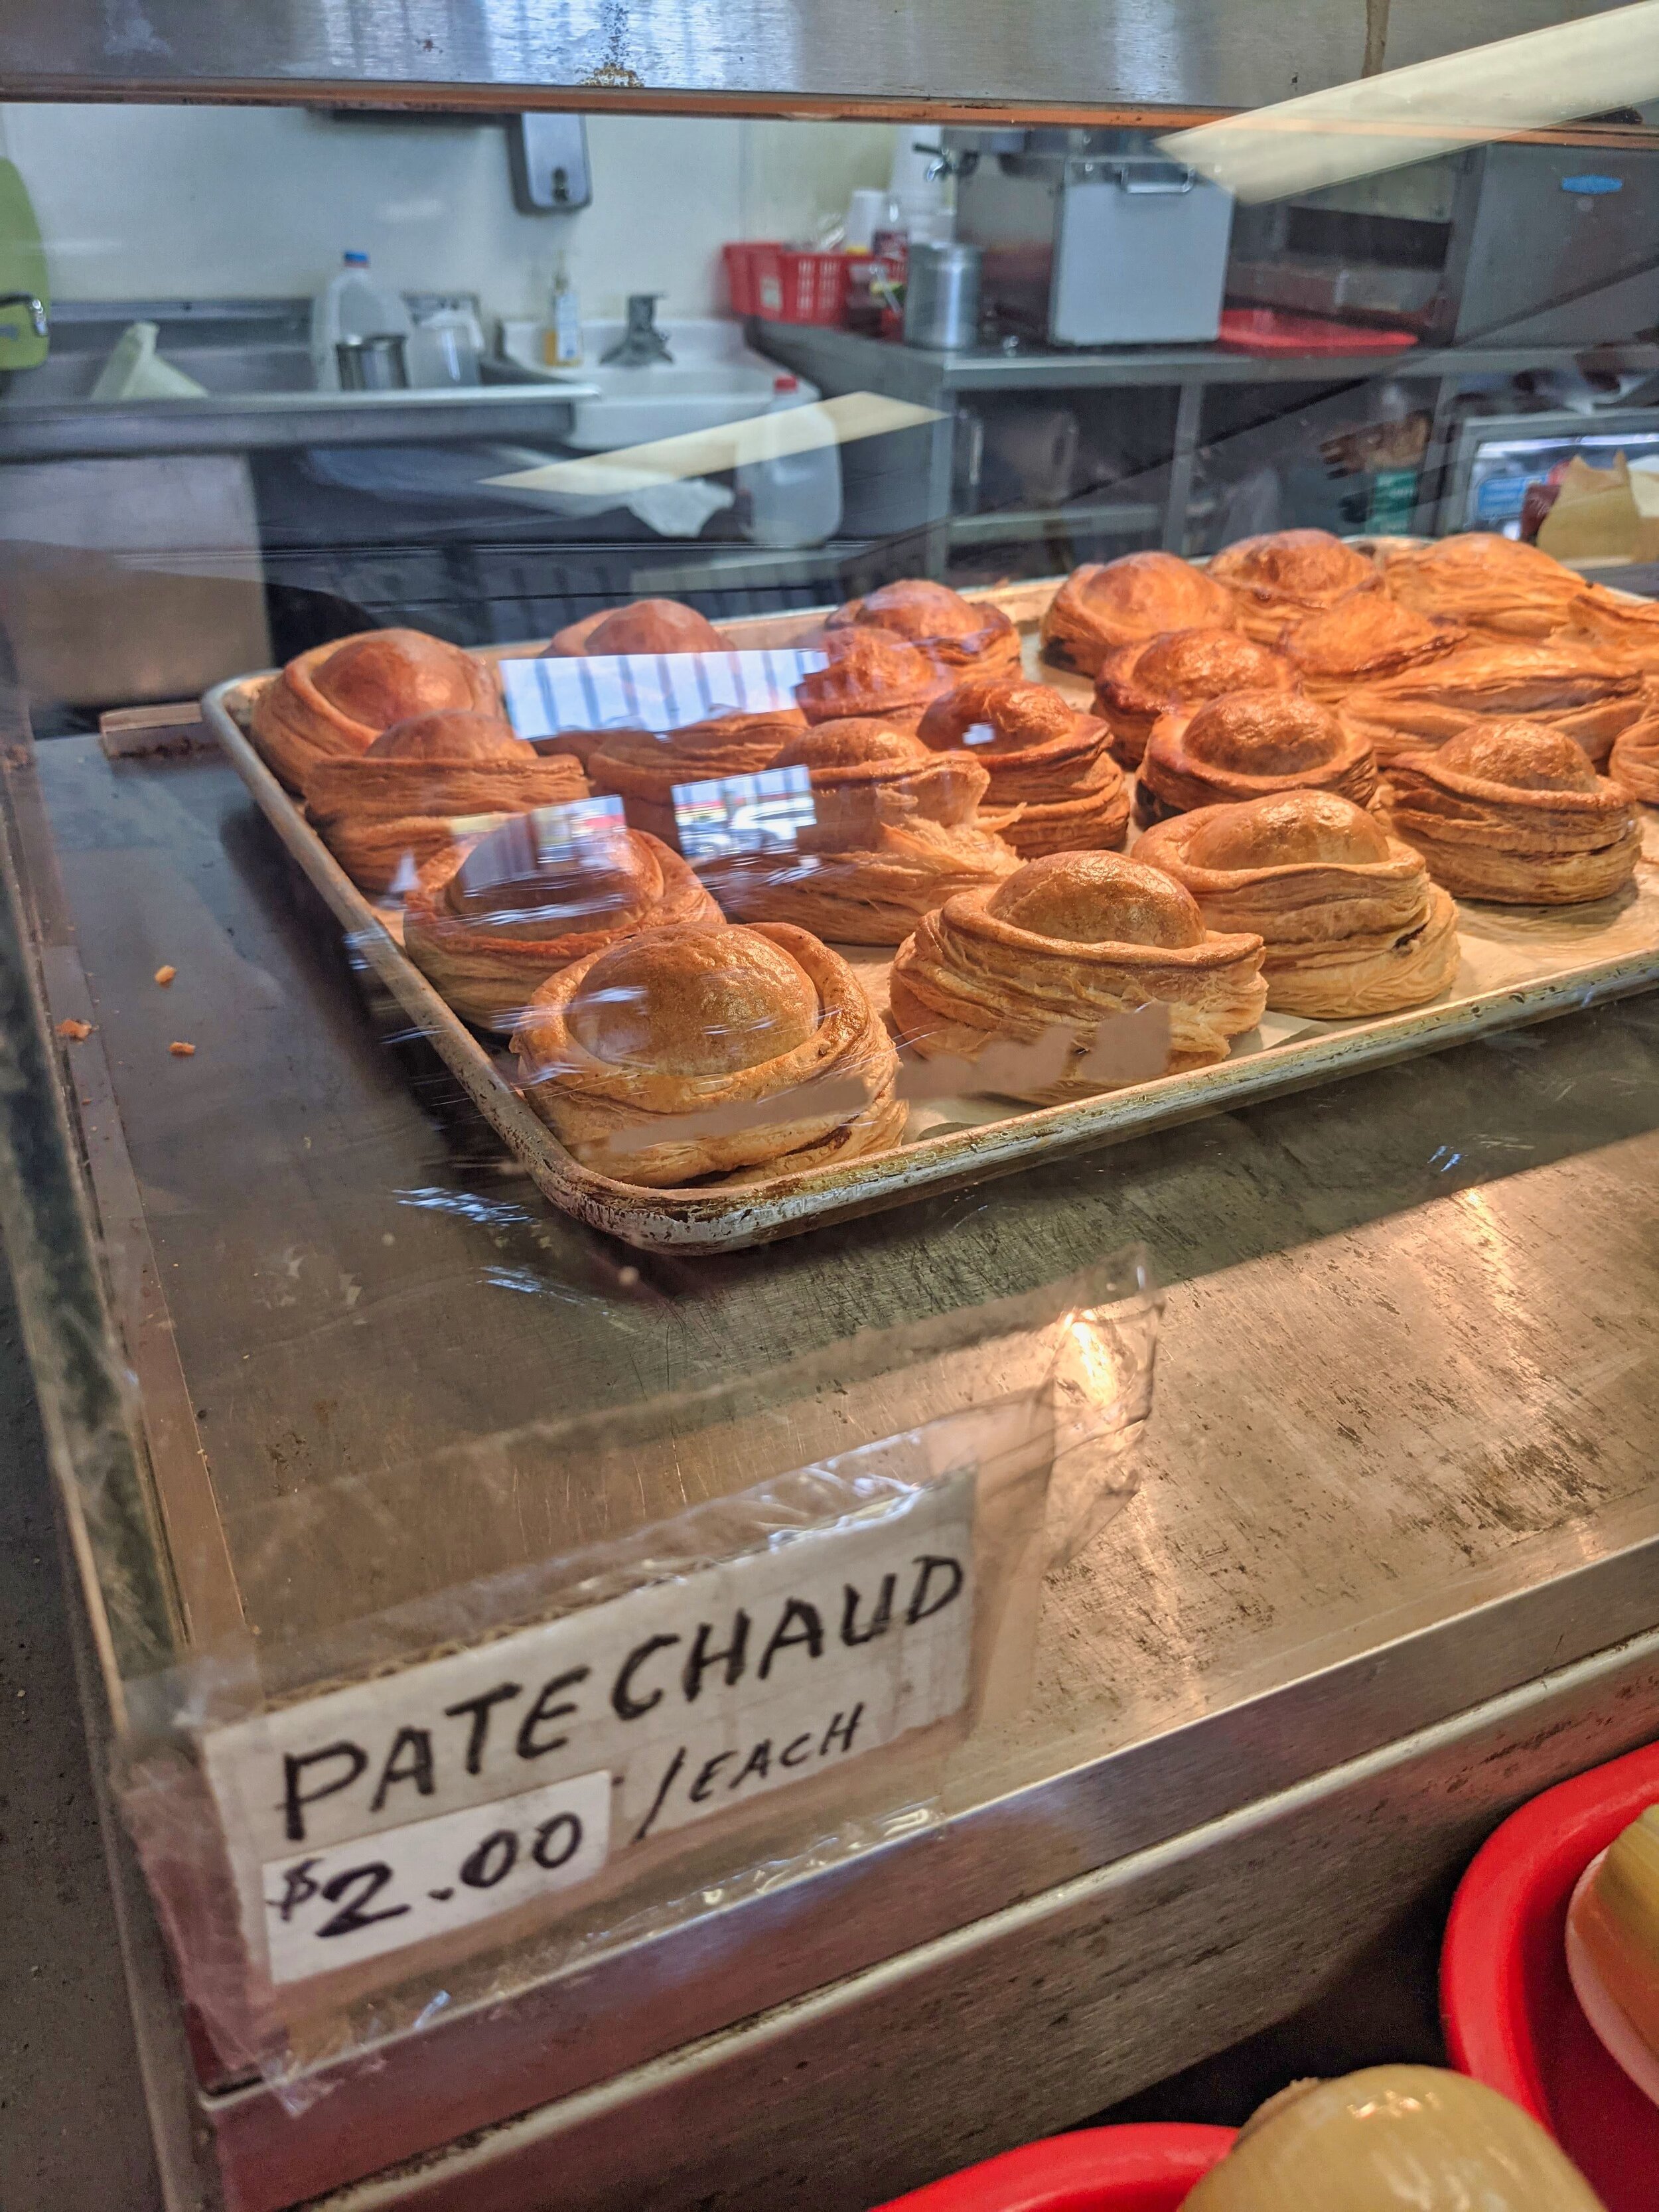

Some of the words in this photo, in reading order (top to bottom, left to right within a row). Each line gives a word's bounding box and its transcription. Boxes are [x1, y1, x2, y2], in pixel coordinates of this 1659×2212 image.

[275, 1665, 594, 1842] PATE
[611, 1555, 964, 1722] CHAUD
[267, 1812, 583, 1938] $2.00
